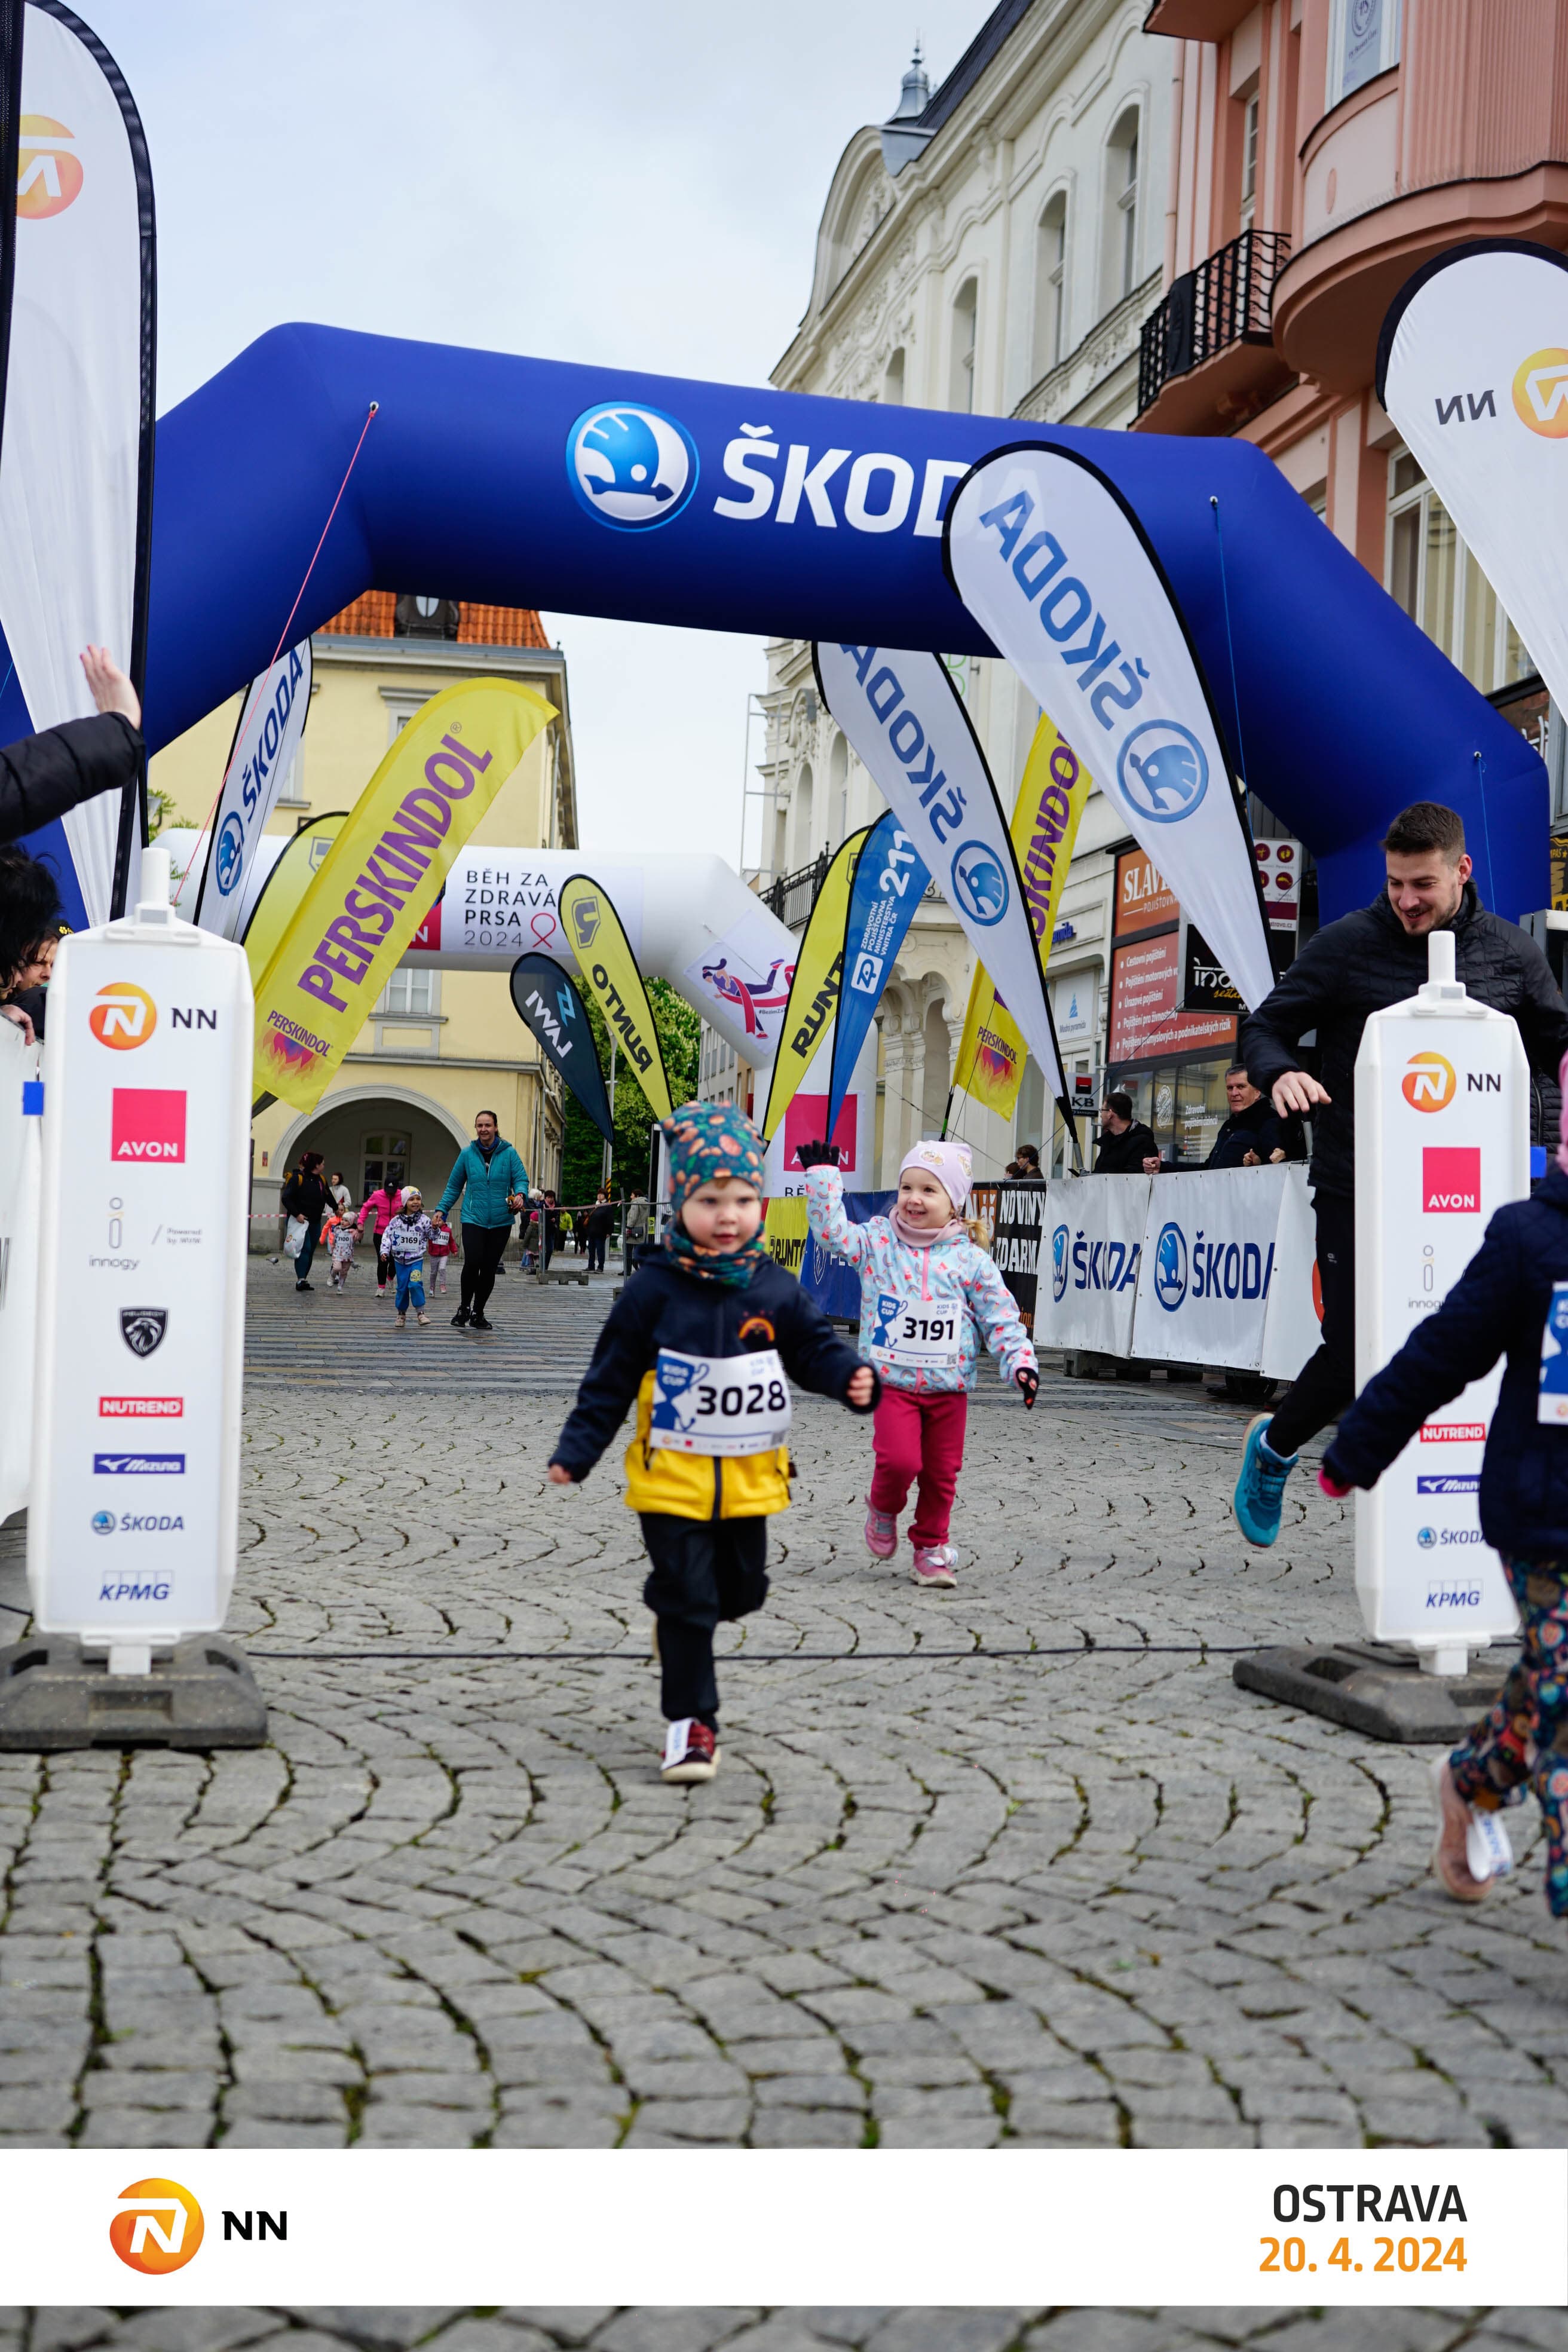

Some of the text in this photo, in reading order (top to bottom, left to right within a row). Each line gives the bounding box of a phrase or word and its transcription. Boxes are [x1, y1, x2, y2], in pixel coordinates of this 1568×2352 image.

[713, 422, 973, 538] ŠKOD
[242, 648, 303, 824] ŠKODA
[297, 733, 493, 1013] PERSKINDOL
[467, 868, 548, 887] BĚH ZA
[465, 889, 556, 907] ZDRAVÁ
[465, 909, 521, 926] PRSA
[860, 901, 879, 950] ZDRAVOTNÍ
[874, 896, 896, 954] MINISTERSTVA
[464, 930, 523, 947] 2024
[880, 911, 899, 956] VNITRA ČR
[1126, 947, 1166, 967] Cestovní pojištění
[1125, 973, 1145, 989] Pojištění
[1145, 966, 1173, 982] motorových
[1125, 989, 1163, 1008] Úrazové pojištění
[171, 1007, 217, 1030] NN
[1123, 1014, 1143, 1030] Pojištění
[267, 1010, 330, 1057] PERSKINDOL
[1122, 1036, 1142, 1052] Pojištění
[1141, 1028, 1174, 1048] průmyslových
[1178, 1022, 1219, 1040] podnikatelských
[1220, 1017, 1232, 1030] rizik
[976, 1025, 1017, 1064] PERSKINDOL
[1468, 1073, 1501, 1092] NN
[1071, 1097, 1094, 1107] KB
[118, 1141, 178, 1157] AVON
[791, 1147, 849, 1165] AN
[999, 1190, 1046, 1227] NOVINY
[1428, 1194, 1475, 1208] AVON
[88, 1255, 139, 1270] innogy
[995, 1237, 1038, 1275] ZDARM
[881, 1300, 896, 1309] KIDS
[881, 1307, 895, 1316] CUP
[903, 1316, 954, 1341] 3191
[103, 1401, 181, 1414] NUTREND
[696, 1380, 786, 1416] 3028
[1422, 1426, 1484, 1440] NUTREND
[120, 1513, 184, 1532] ŠKODA
[99, 1583, 170, 1601] KPMG
[1426, 1591, 1481, 1608] KPMG
